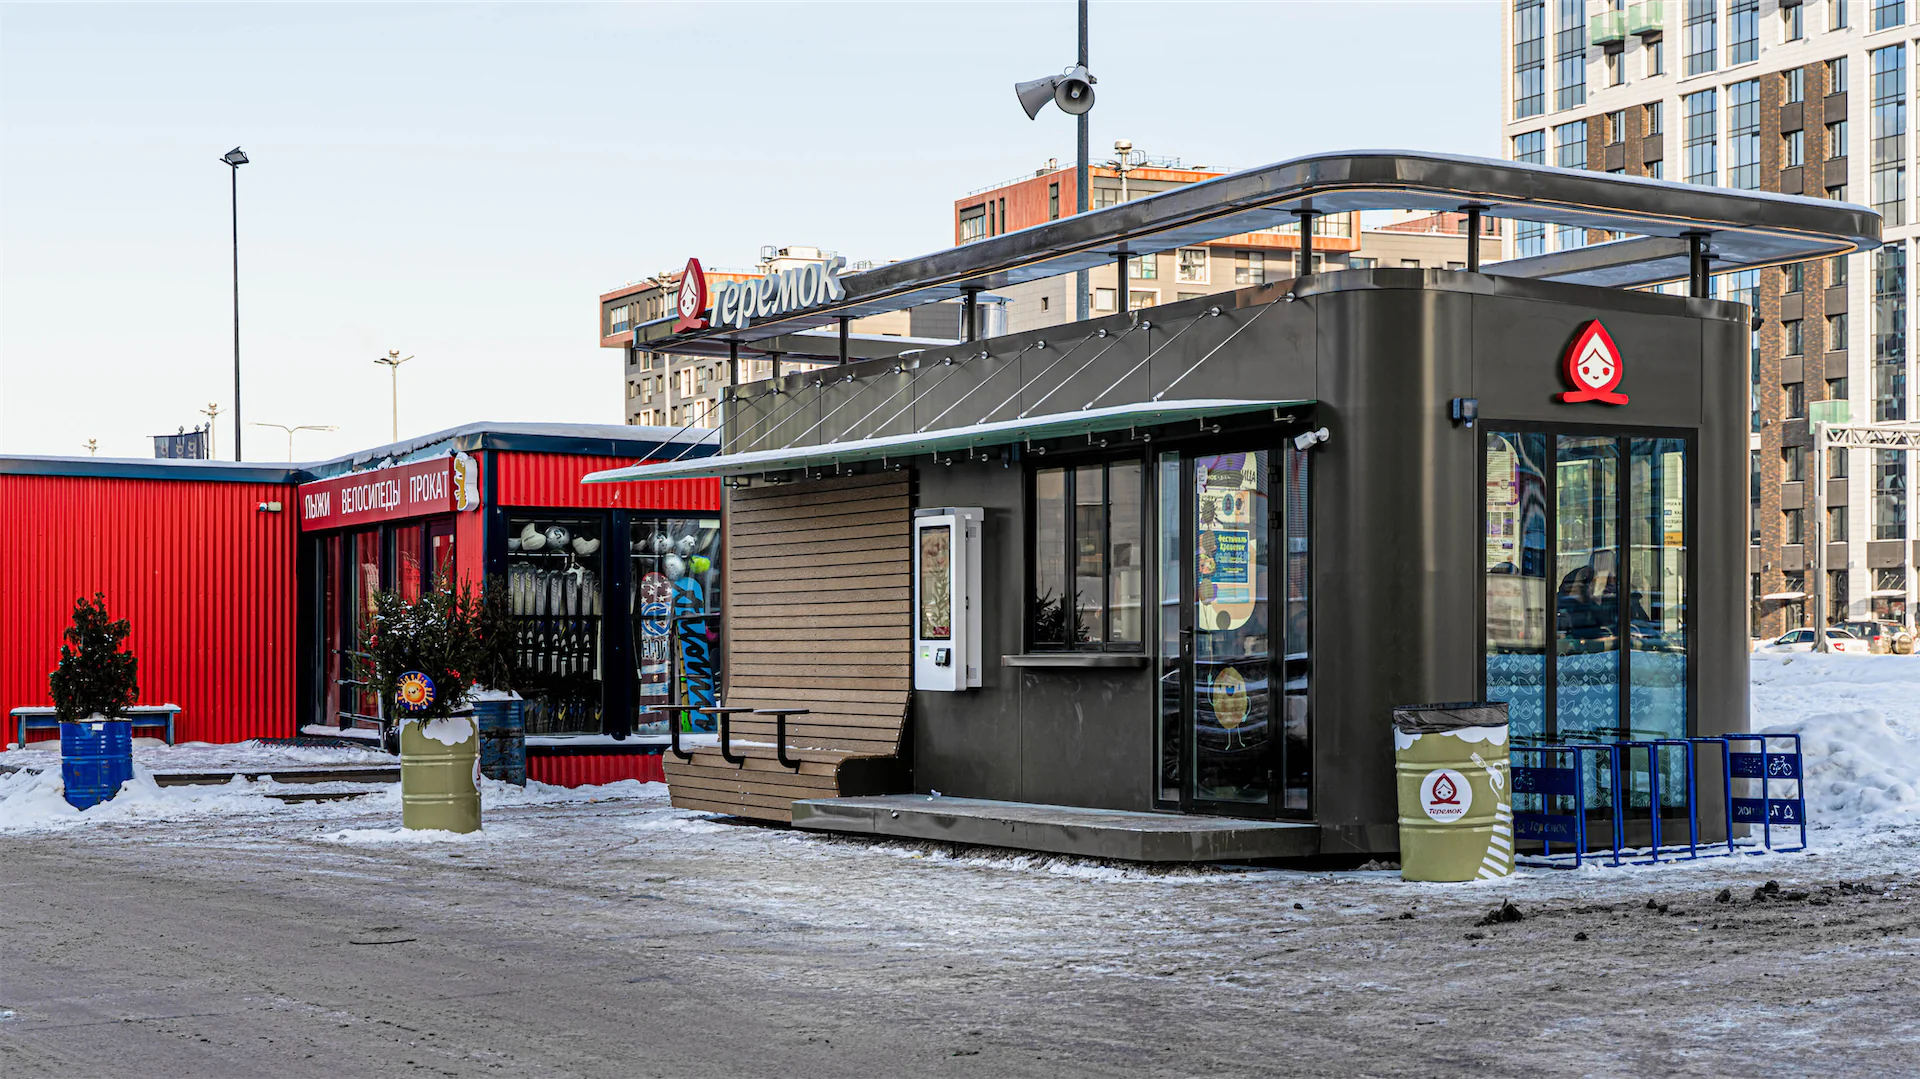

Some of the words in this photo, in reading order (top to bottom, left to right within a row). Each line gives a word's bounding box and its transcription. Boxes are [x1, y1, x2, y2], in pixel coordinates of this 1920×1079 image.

[305, 491, 331, 520] ЛЫЖИ
[341, 478, 400, 515] ВЕЛОСИПЕДЫ
[409, 470, 448, 504] ПРОКАТ
